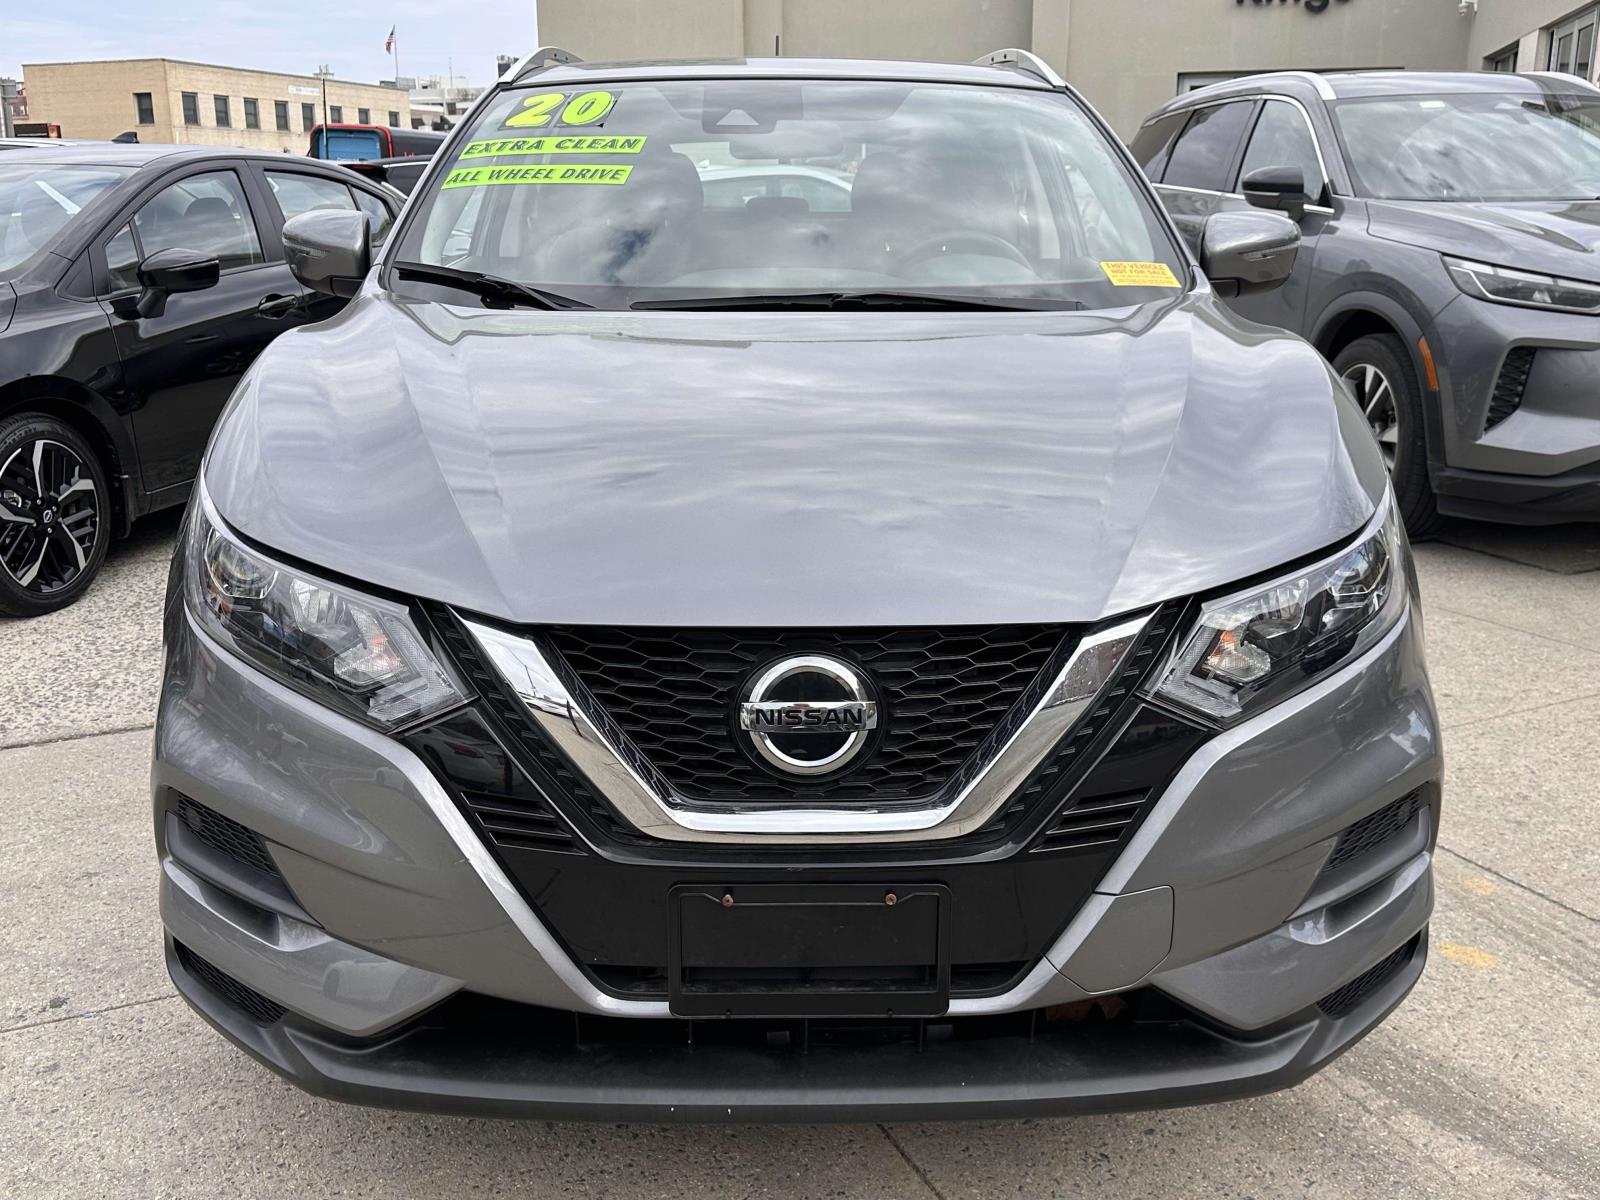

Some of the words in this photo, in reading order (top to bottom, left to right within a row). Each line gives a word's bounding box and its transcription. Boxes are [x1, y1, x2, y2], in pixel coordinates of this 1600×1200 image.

[504, 90, 616, 127] 20
[463, 138, 545, 156] EXTRA
[554, 138, 641, 150] CLEAN
[445, 169, 481, 184] ALL
[487, 168, 554, 181] WHEEL
[559, 168, 627, 180] DRIVE
[755, 708, 862, 726] NISSAN
